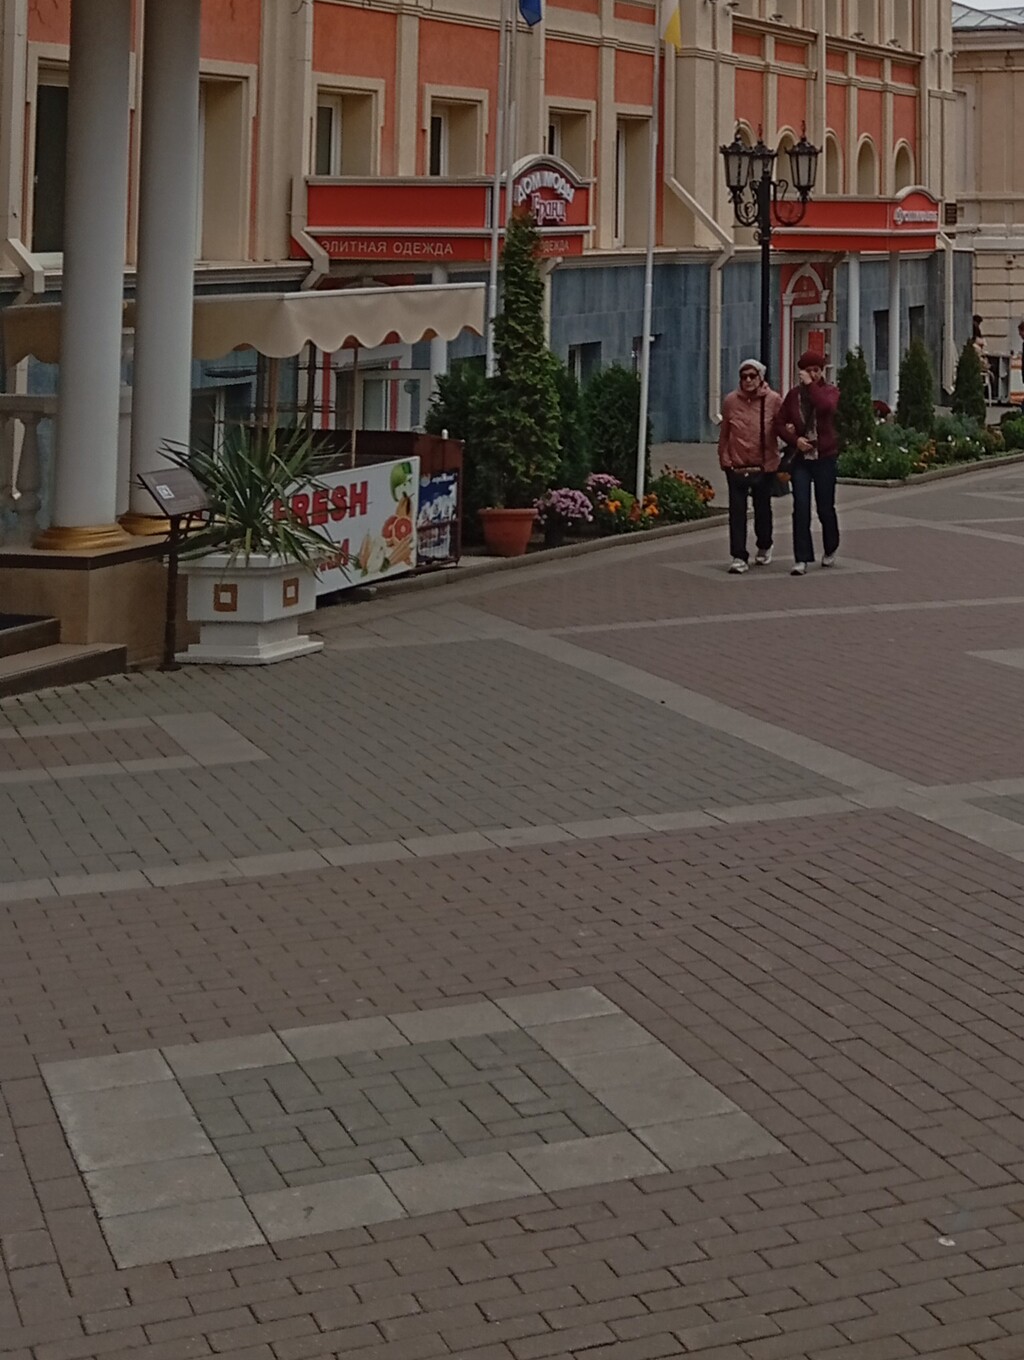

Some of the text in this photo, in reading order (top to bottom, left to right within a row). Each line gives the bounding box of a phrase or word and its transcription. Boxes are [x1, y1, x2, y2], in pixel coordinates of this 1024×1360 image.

[513, 171, 575, 206] ДОМ МОДЫ
[321, 240, 453, 256] ЭЛИТНАЯ ОДЕЖДА
[273, 481, 369, 528] FRESH
